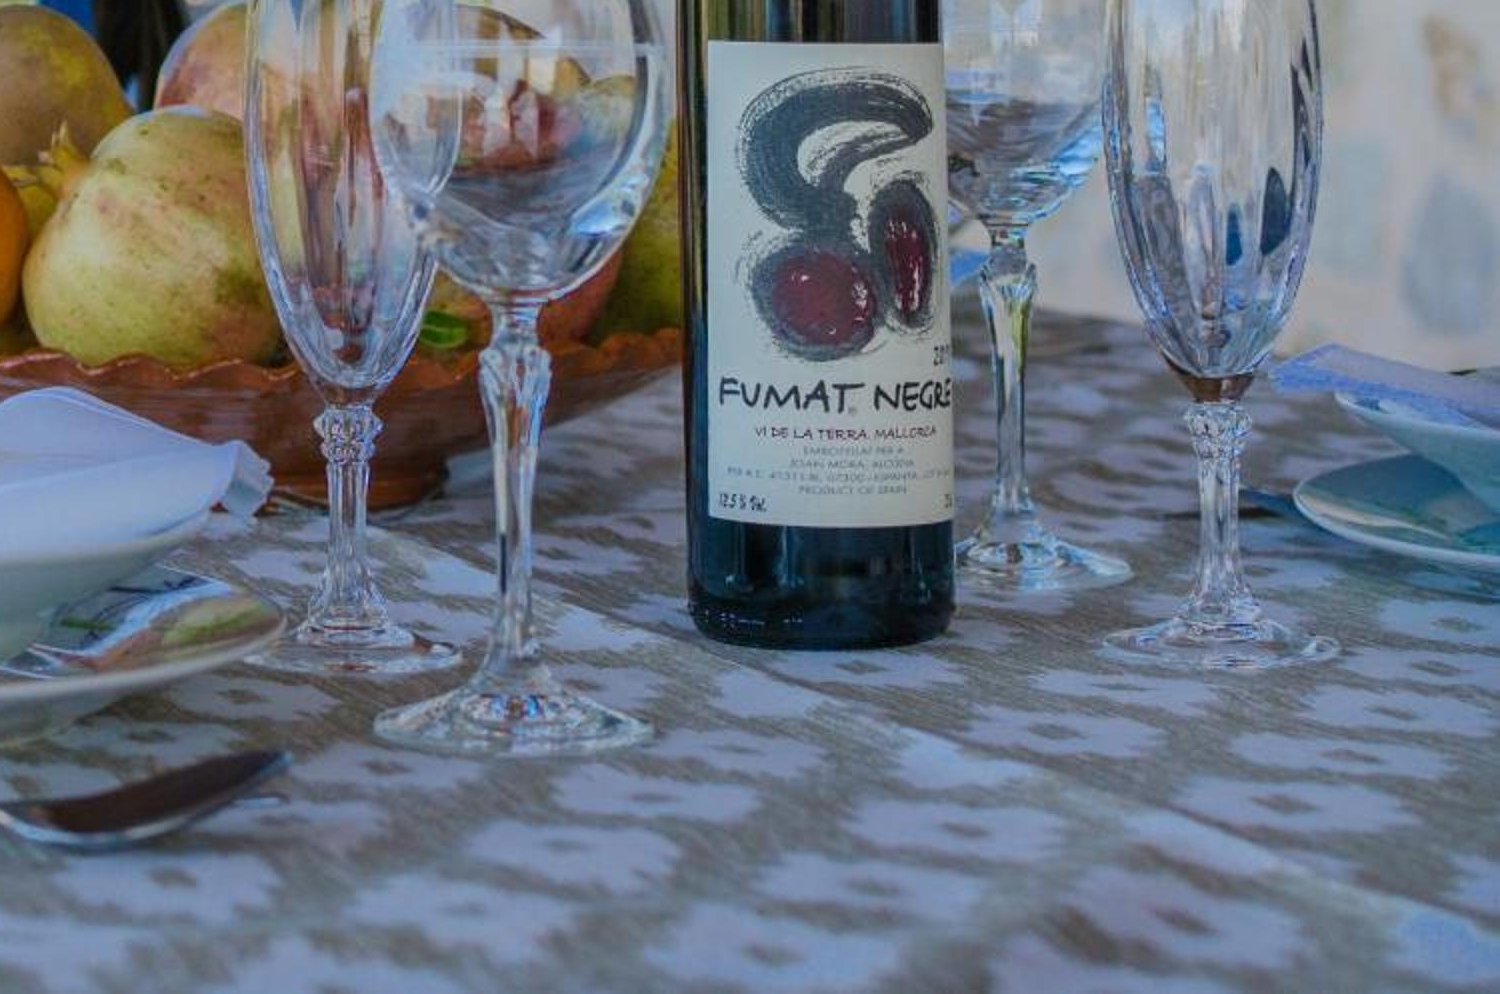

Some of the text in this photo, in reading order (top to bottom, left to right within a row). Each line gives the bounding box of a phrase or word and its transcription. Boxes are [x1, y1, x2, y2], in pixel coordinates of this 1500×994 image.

[719, 376, 952, 414] FUMAT NEGRE
[756, 426, 767, 437] VI
[771, 426, 788, 438] DE
[793, 429, 813, 439] LA
[875, 426, 937, 439] MALLORCA
